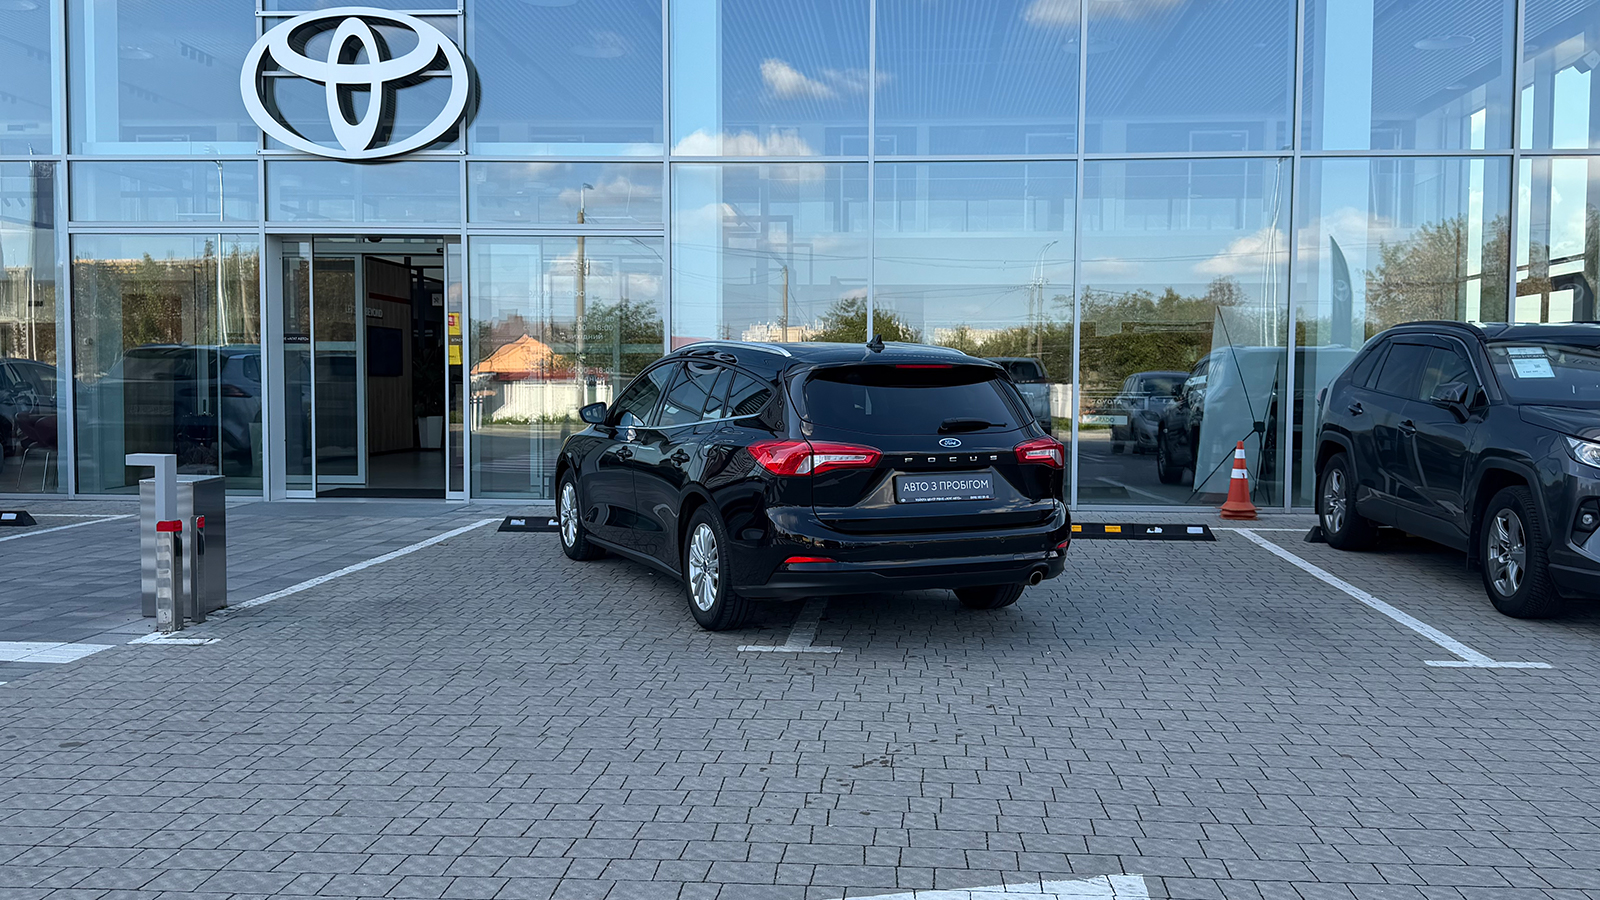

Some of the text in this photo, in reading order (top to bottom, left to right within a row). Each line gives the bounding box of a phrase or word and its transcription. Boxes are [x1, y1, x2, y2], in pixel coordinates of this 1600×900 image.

[904, 455, 998, 463] FOCUS
[904, 481, 928, 492] АВТО
[940, 480, 988, 490] ПРОБІГОМ
